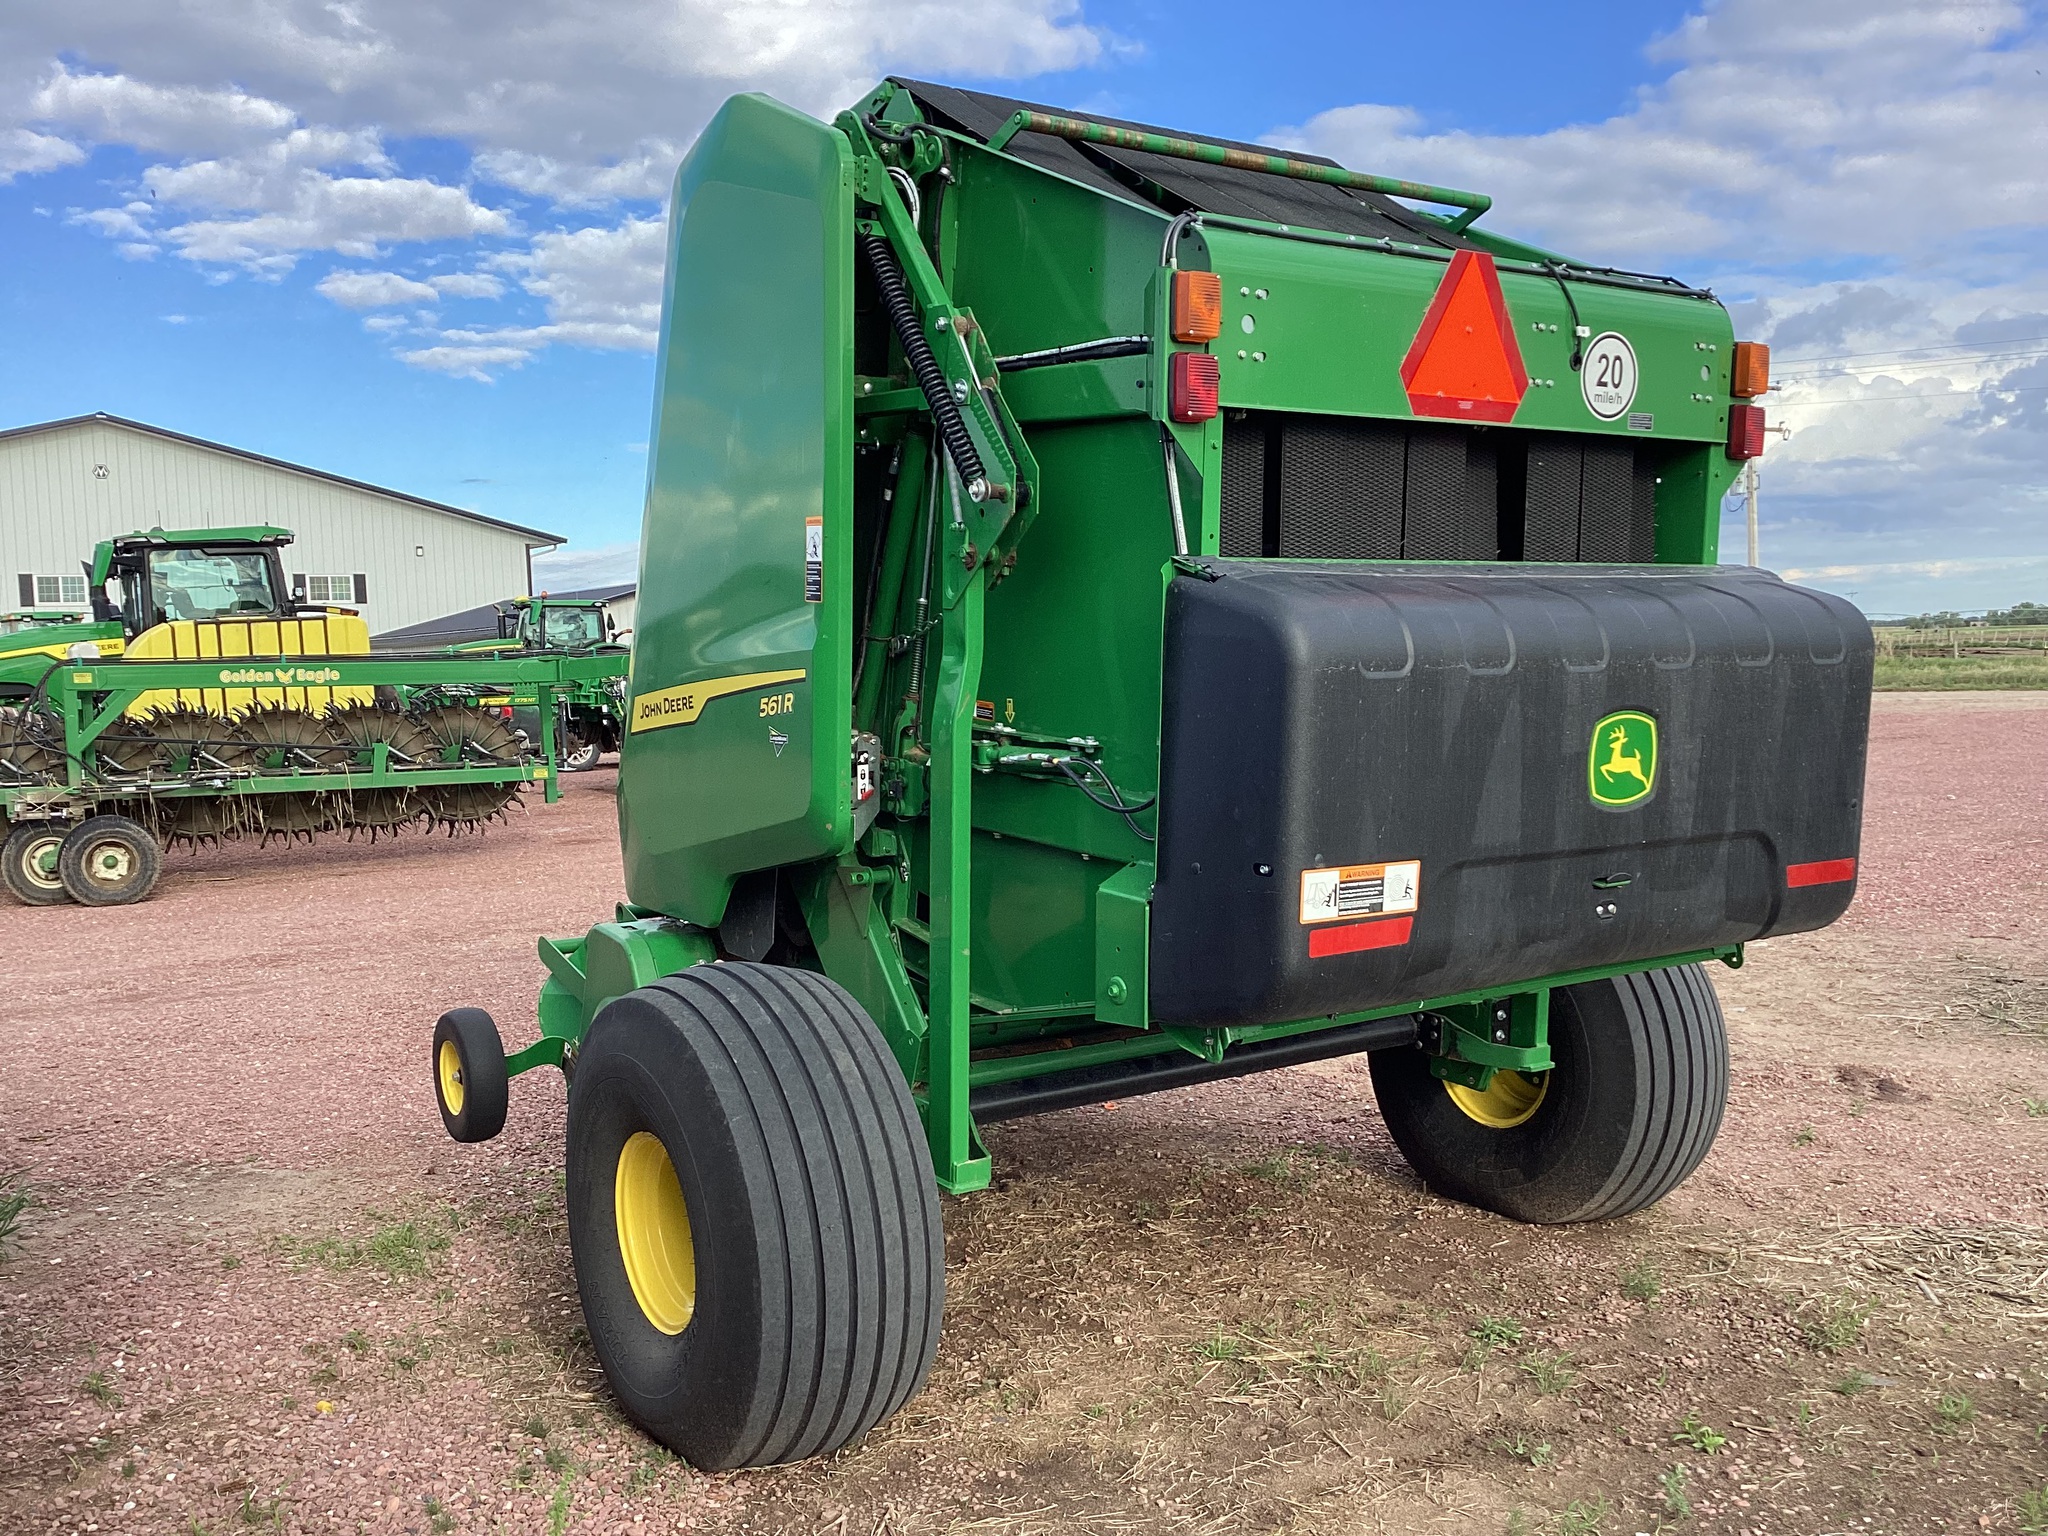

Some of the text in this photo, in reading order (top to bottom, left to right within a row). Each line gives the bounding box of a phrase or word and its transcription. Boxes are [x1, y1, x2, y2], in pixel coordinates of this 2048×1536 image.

[1596, 353, 1623, 390] 20
[1593, 391, 1623, 405] mile/h
[220, 666, 340, 684] Golden Eagle
[639, 695, 694, 720] JOHN DEERE
[1351, 869, 1381, 879] WARNING
